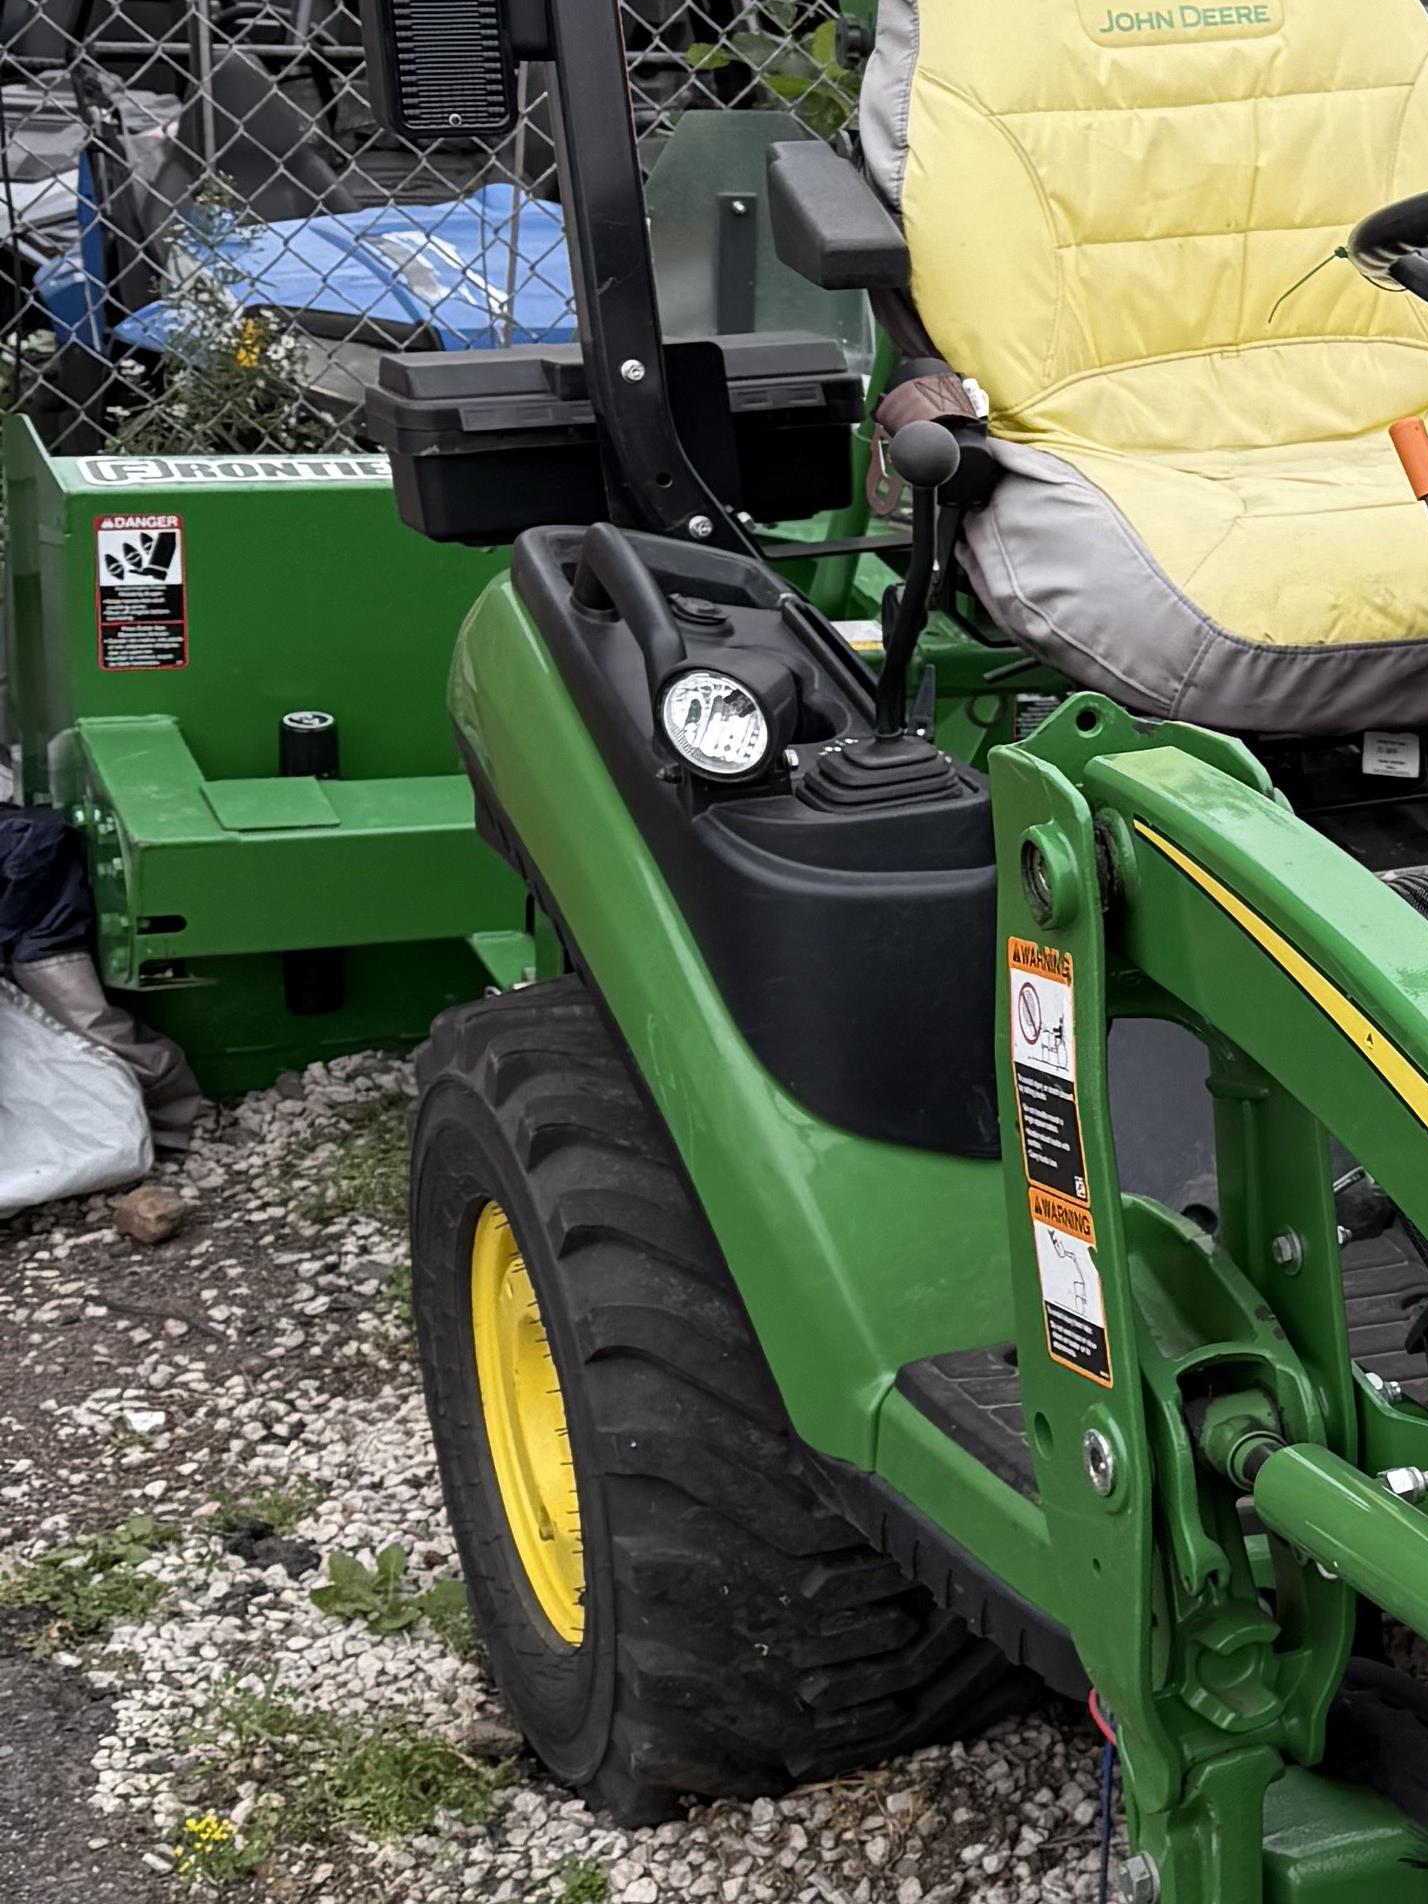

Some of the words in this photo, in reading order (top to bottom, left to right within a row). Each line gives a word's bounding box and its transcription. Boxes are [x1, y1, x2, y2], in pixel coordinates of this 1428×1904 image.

[1099, 9, 1175, 33] JOHN
[1179, 5, 1271, 28] DEERE
[87, 459, 392, 482] FRONTIE
[114, 516, 178, 529] DANGER
[1042, 1199, 1091, 1235] WARNING
